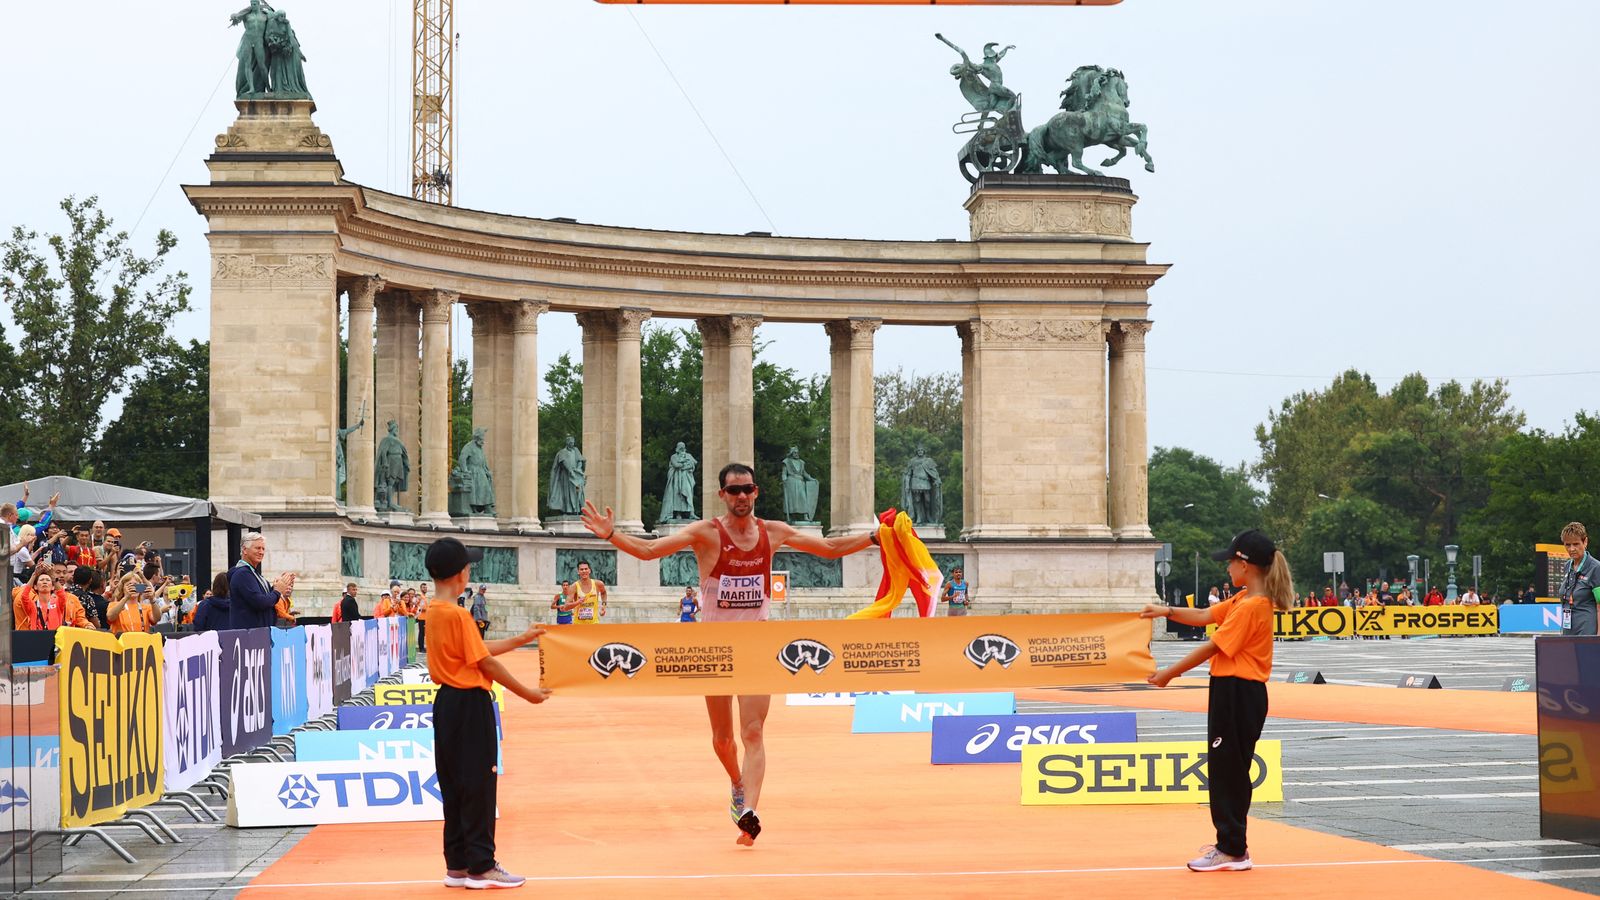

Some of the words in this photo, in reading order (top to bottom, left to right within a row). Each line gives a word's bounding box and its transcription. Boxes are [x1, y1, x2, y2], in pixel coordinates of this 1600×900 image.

[731, 577, 760, 587] TDK
[1273, 608, 1346, 636] IKO
[1393, 612, 1497, 629] PROSPEX
[842, 643, 872, 651] WORLD
[874, 641, 920, 650] ATHLETICS
[1028, 637, 1058, 645] WORLD
[1060, 635, 1105, 644] ATHLETICS
[655, 647, 685, 655] WORLD
[687, 646, 733, 654] ATHLETICS
[842, 650, 920, 659] CHAMPIONSHIPS
[1028, 643, 1106, 653] CHAMPIONSHIPS
[655, 655, 734, 664] CHAMPIONSHIPS
[843, 659, 905, 669] BUDAPEST
[907, 658, 920, 667] 23
[1030, 652, 1091, 663] BUDAPEST
[1093, 651, 1106, 660] 23
[656, 664, 718, 673] BUDAPEST
[719, 663, 734, 672] 23
[280, 643, 296, 718] NTN
[243, 647, 266, 734] asics
[187, 649, 215, 765] TDK
[901, 701, 964, 723] NTN
[68, 641, 160, 818] SEIKO
[1006, 724, 1098, 750] asics
[358, 740, 435, 760] NTN
[316, 770, 444, 808] TDK
